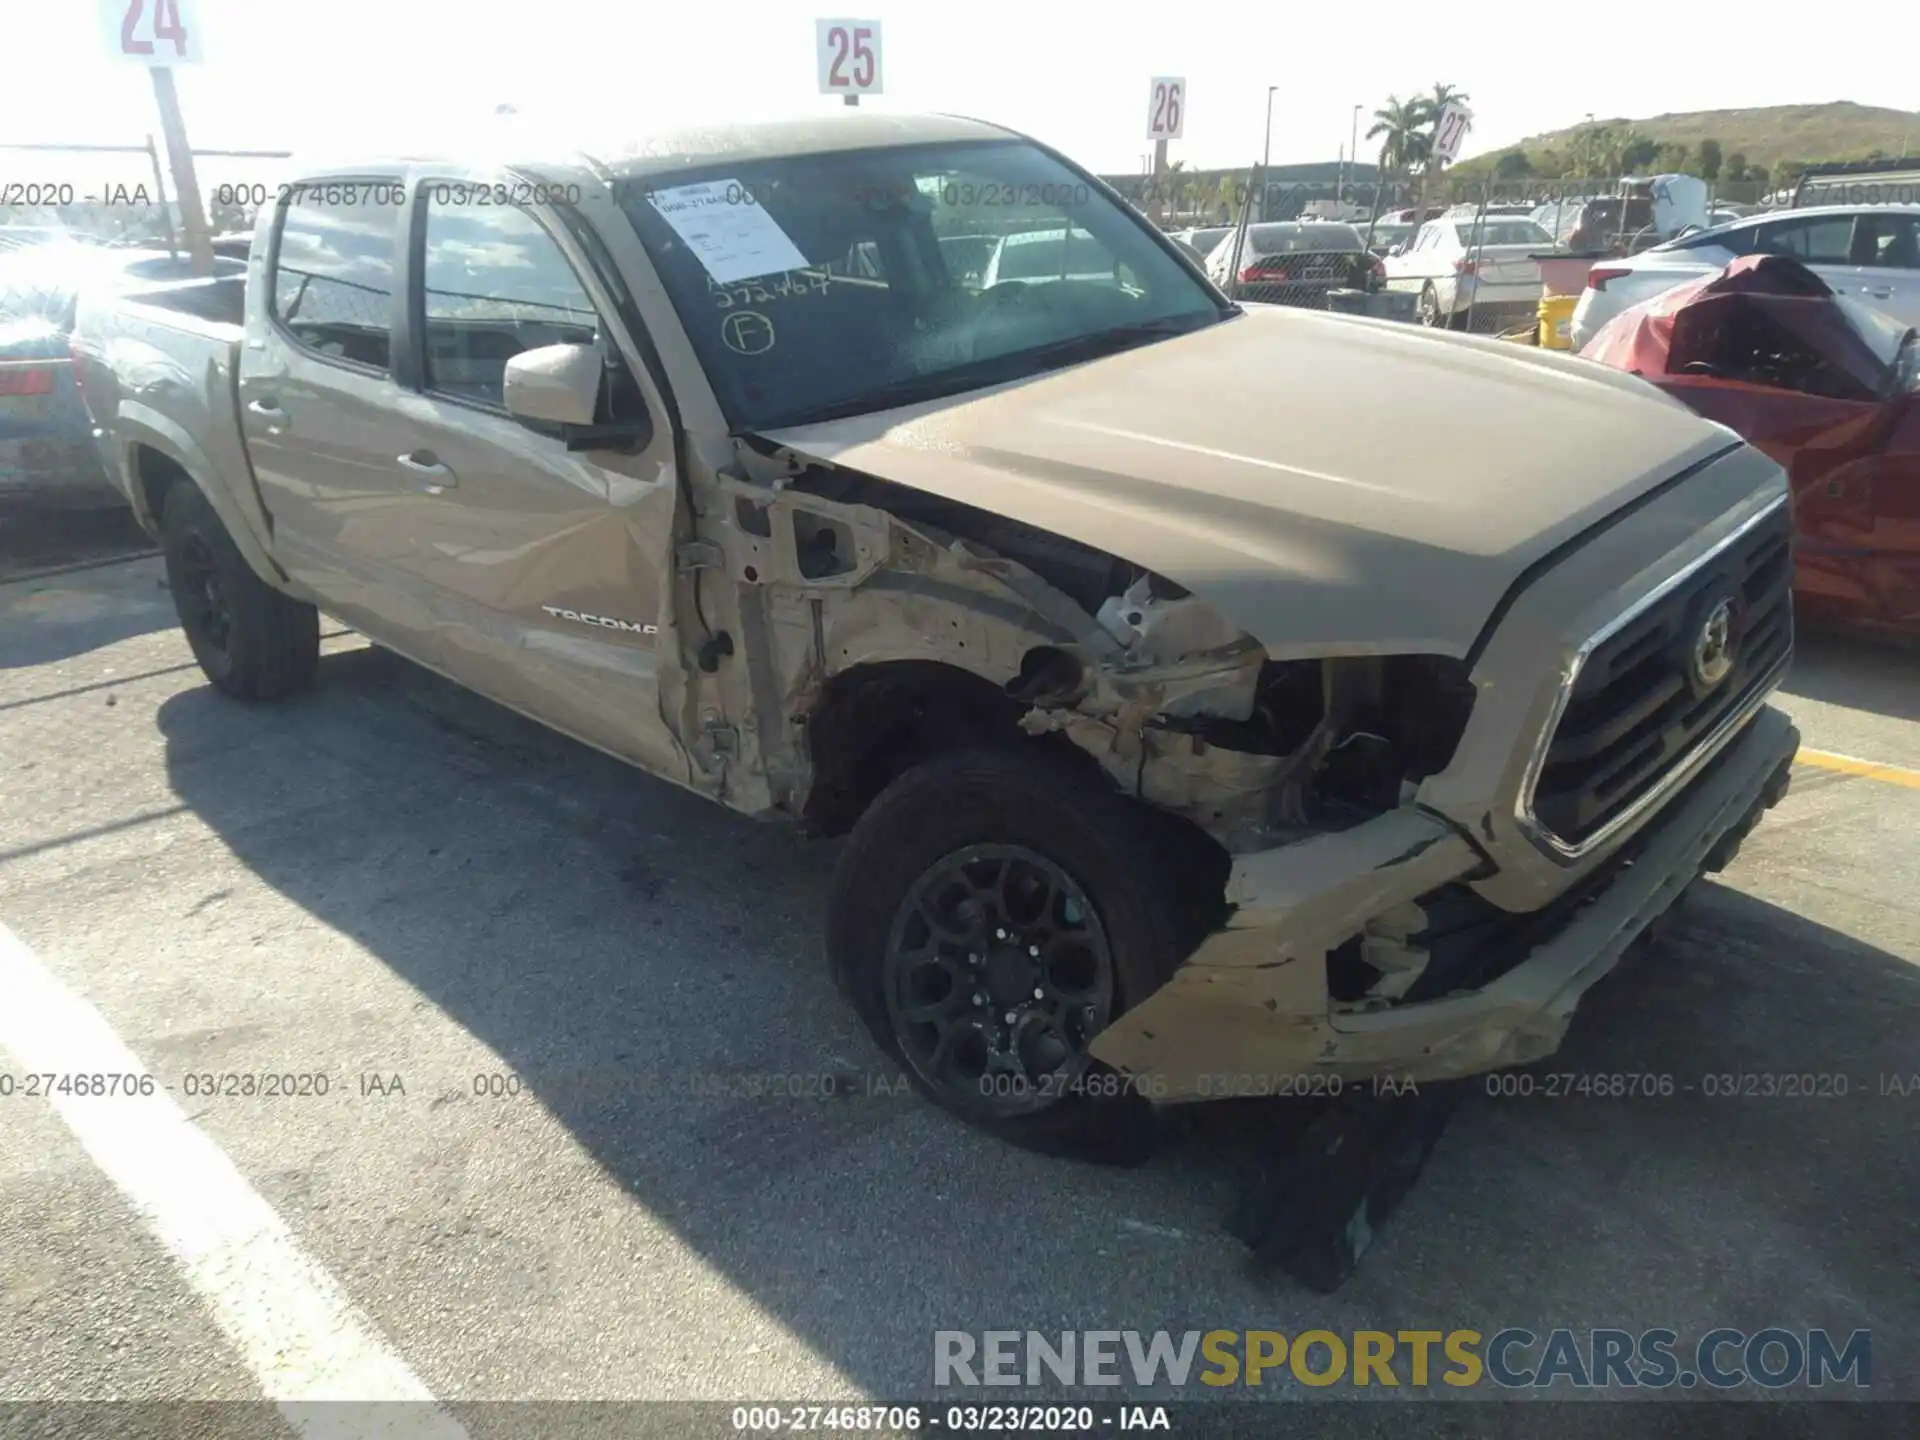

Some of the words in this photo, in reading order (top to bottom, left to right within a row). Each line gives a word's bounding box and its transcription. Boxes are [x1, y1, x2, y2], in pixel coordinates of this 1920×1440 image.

[828, 26, 874, 88] 25
[1152, 82, 1180, 133] 26
[1439, 111, 1466, 152] 27
